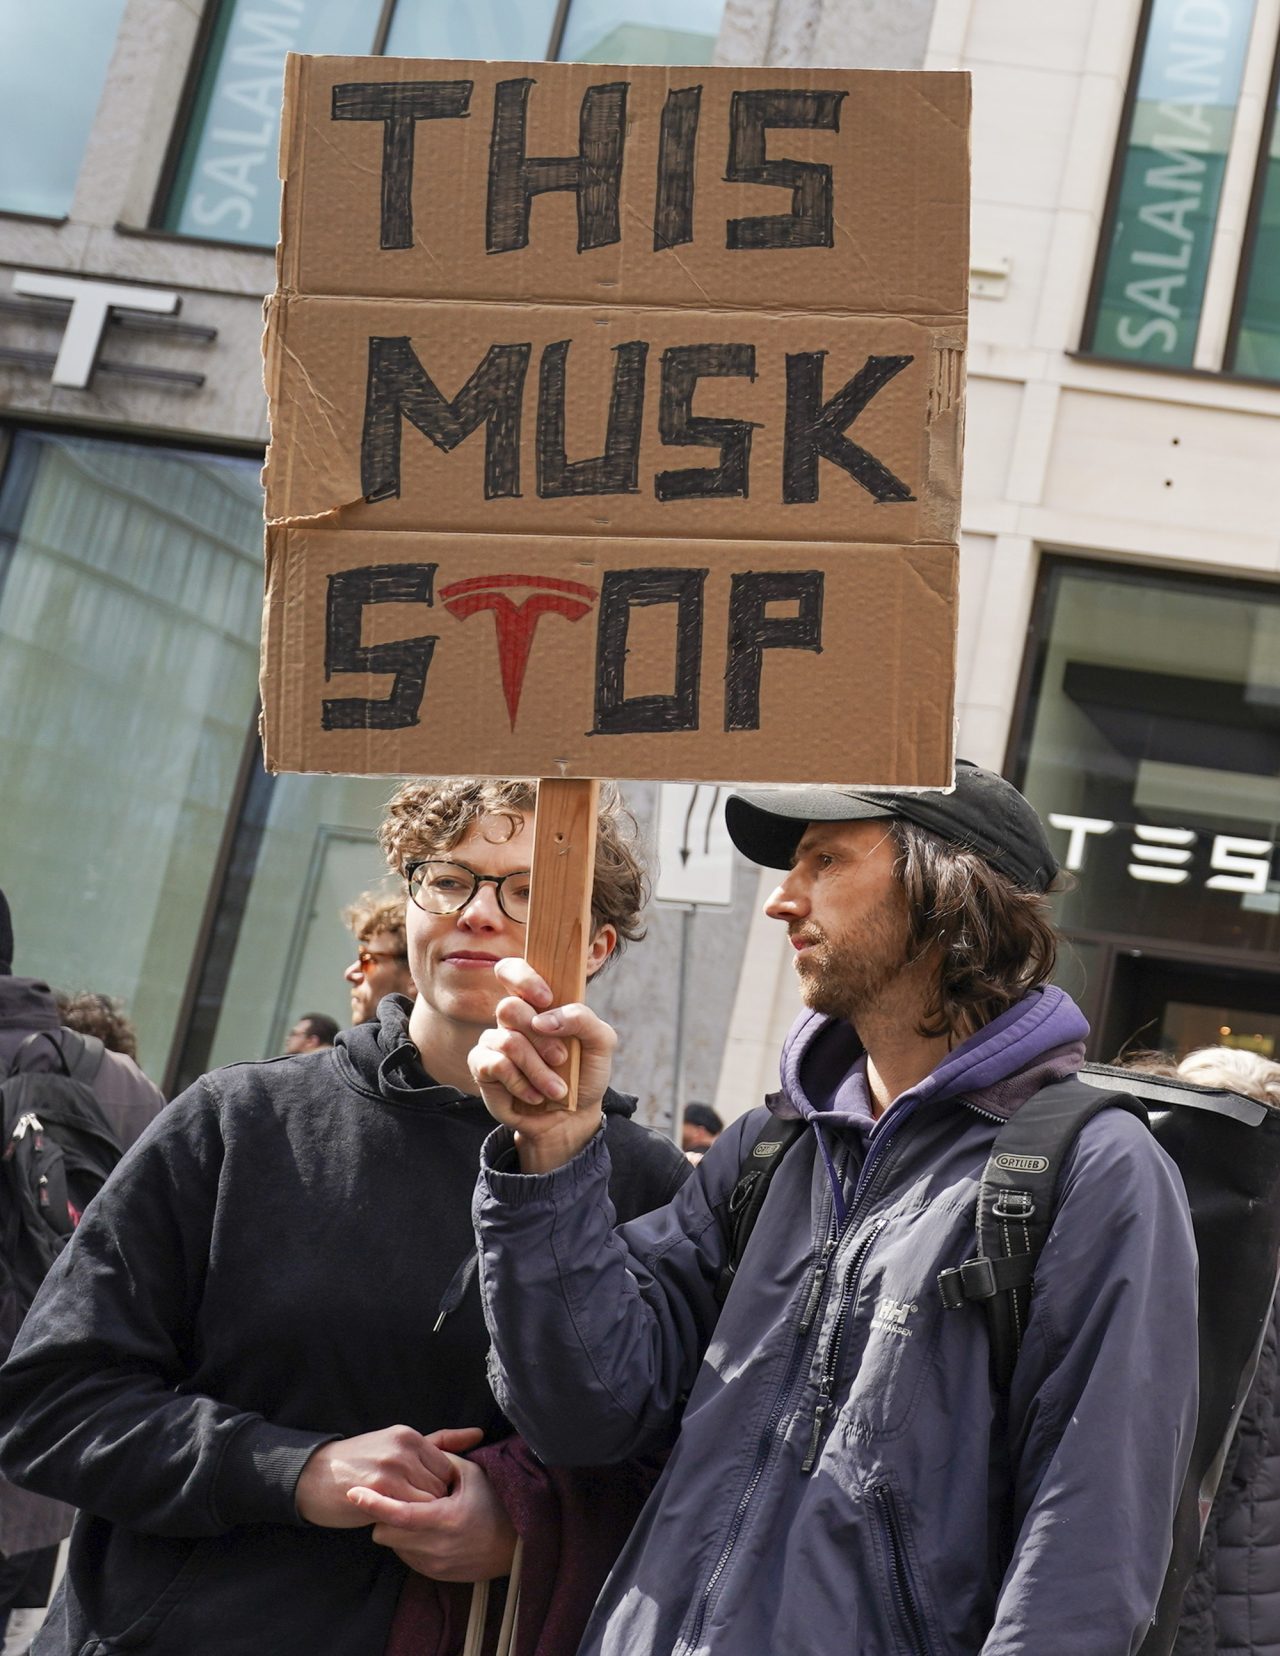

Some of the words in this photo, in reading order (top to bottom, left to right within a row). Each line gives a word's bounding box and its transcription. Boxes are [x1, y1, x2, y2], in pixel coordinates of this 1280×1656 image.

[190, 0, 305, 230] SALAM
[330, 78, 849, 254] THIS
[12, 271, 180, 389] T
[361, 335, 916, 505] MUSK
[320, 562, 825, 737] STOP
[1000, 1157, 1040, 1169] ORTLIEB
